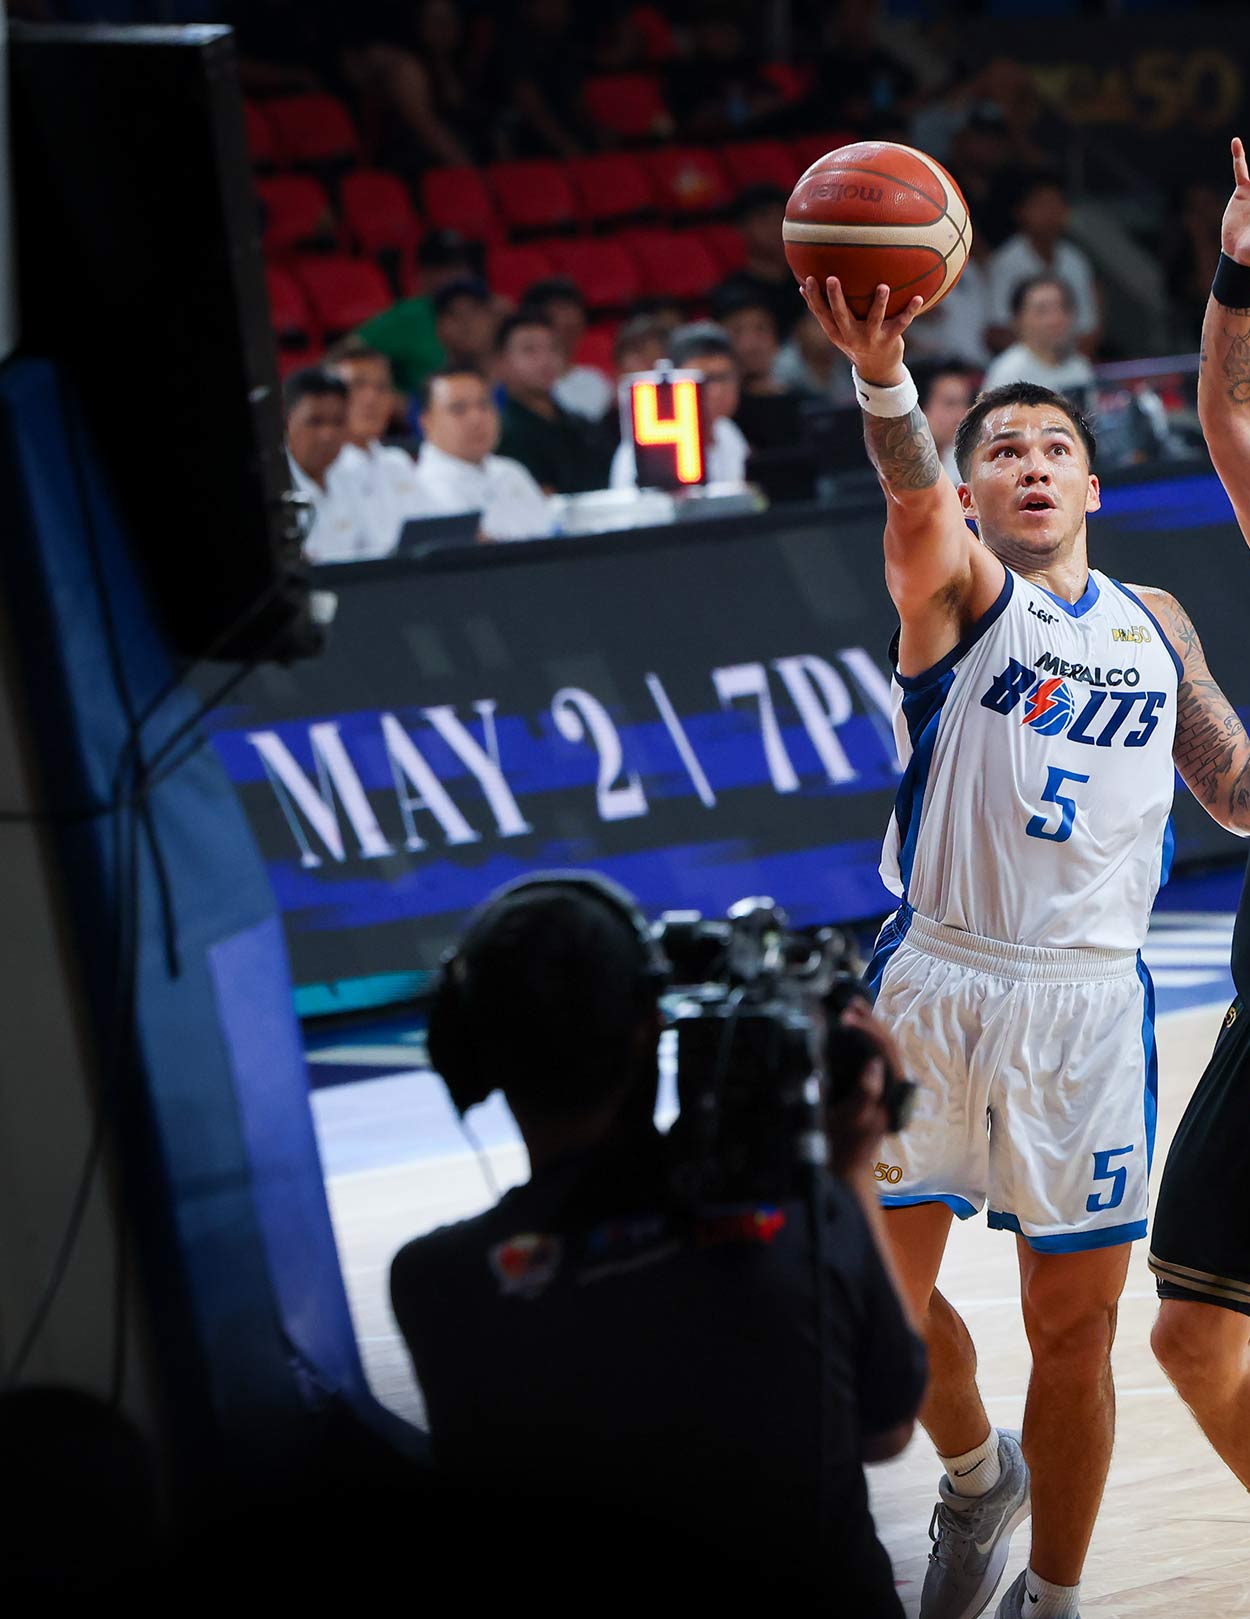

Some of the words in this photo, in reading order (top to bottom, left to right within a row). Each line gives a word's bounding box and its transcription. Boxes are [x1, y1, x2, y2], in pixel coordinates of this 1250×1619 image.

[631, 379, 702, 484] 4
[1034, 652, 1140, 687] MERALCO
[248, 700, 534, 868] MAY
[552, 687, 649, 822] 2
[1026, 766, 1090, 842] 5
[1086, 1144, 1134, 1212] 5
